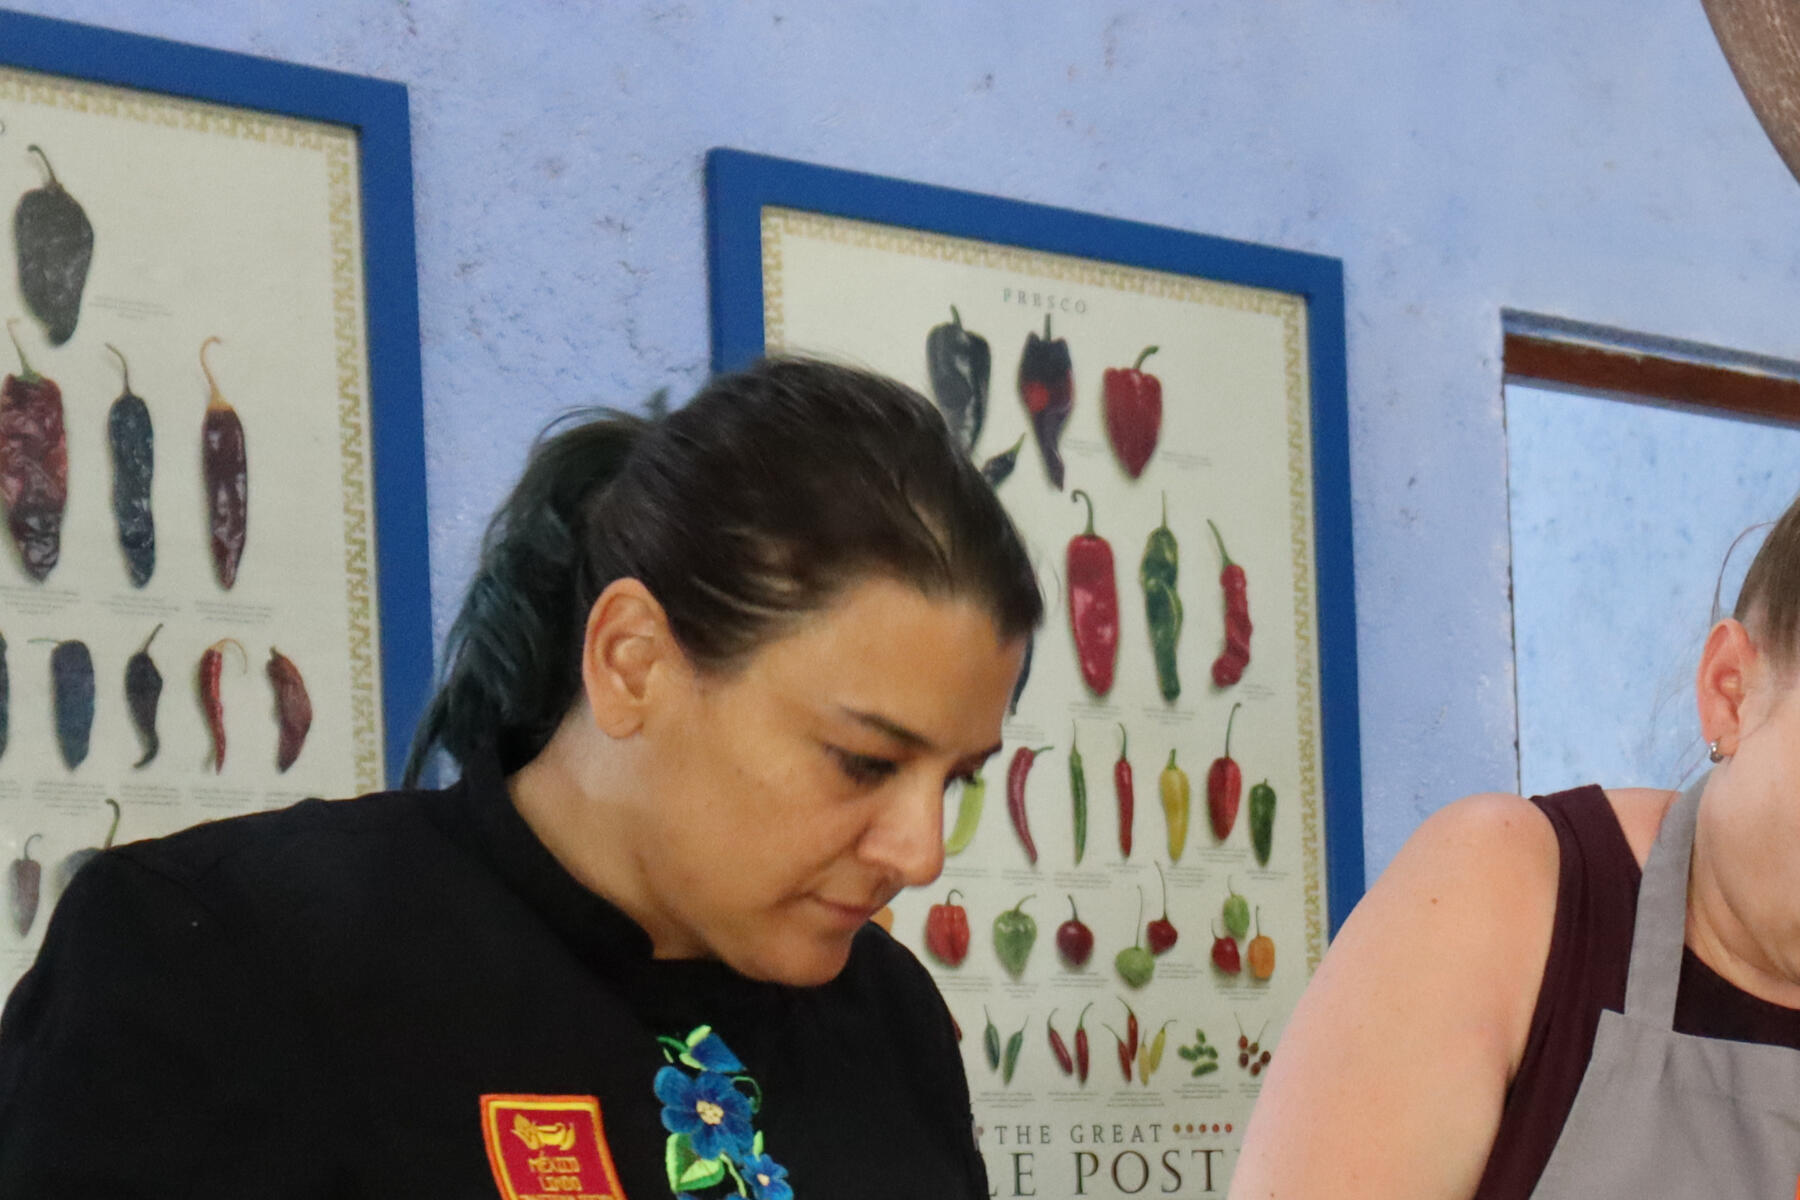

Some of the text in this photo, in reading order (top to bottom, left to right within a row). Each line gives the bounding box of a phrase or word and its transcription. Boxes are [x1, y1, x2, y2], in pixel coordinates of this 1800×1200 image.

[1002, 287, 1087, 315] FRESCO
[994, 1123, 1163, 1145] THE GREAT
[1073, 1149, 1241, 1196] POST
